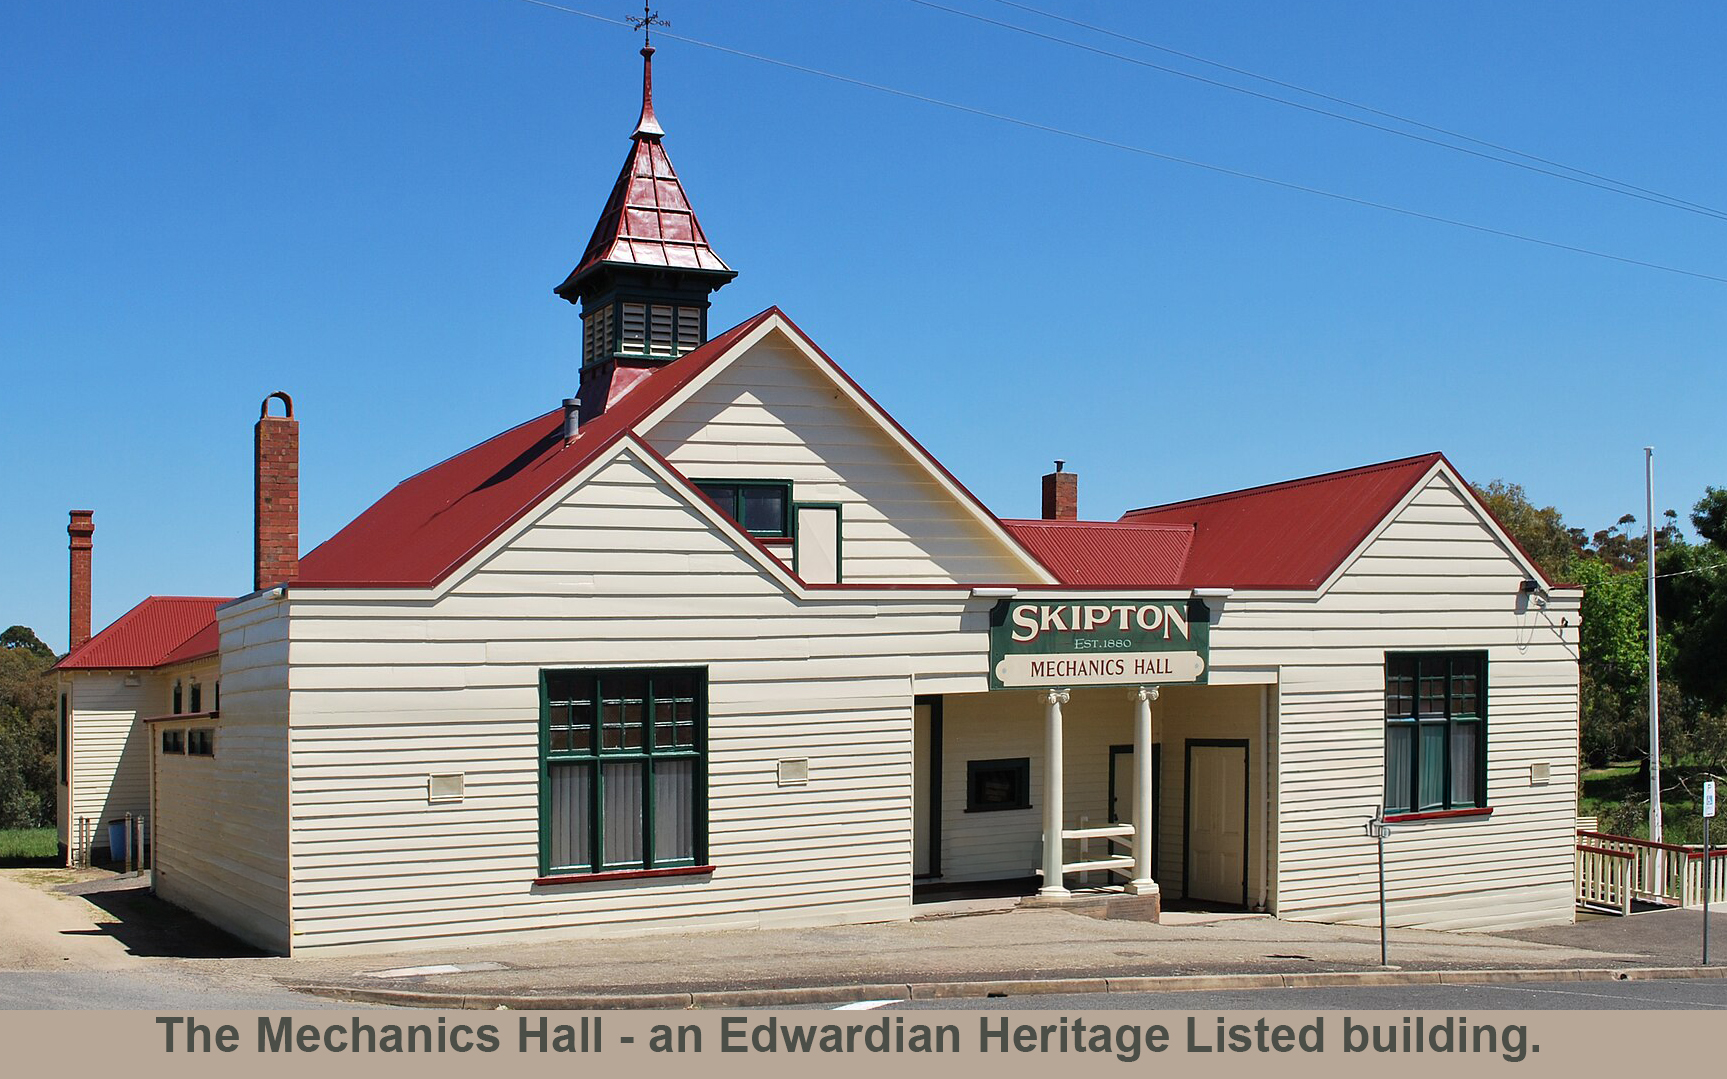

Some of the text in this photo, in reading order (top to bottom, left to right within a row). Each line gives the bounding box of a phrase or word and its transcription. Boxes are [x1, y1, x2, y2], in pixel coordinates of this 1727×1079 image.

[1011, 604, 1190, 642] SKIPTON
[1031, 658, 1173, 677] MECHANICS HALL
